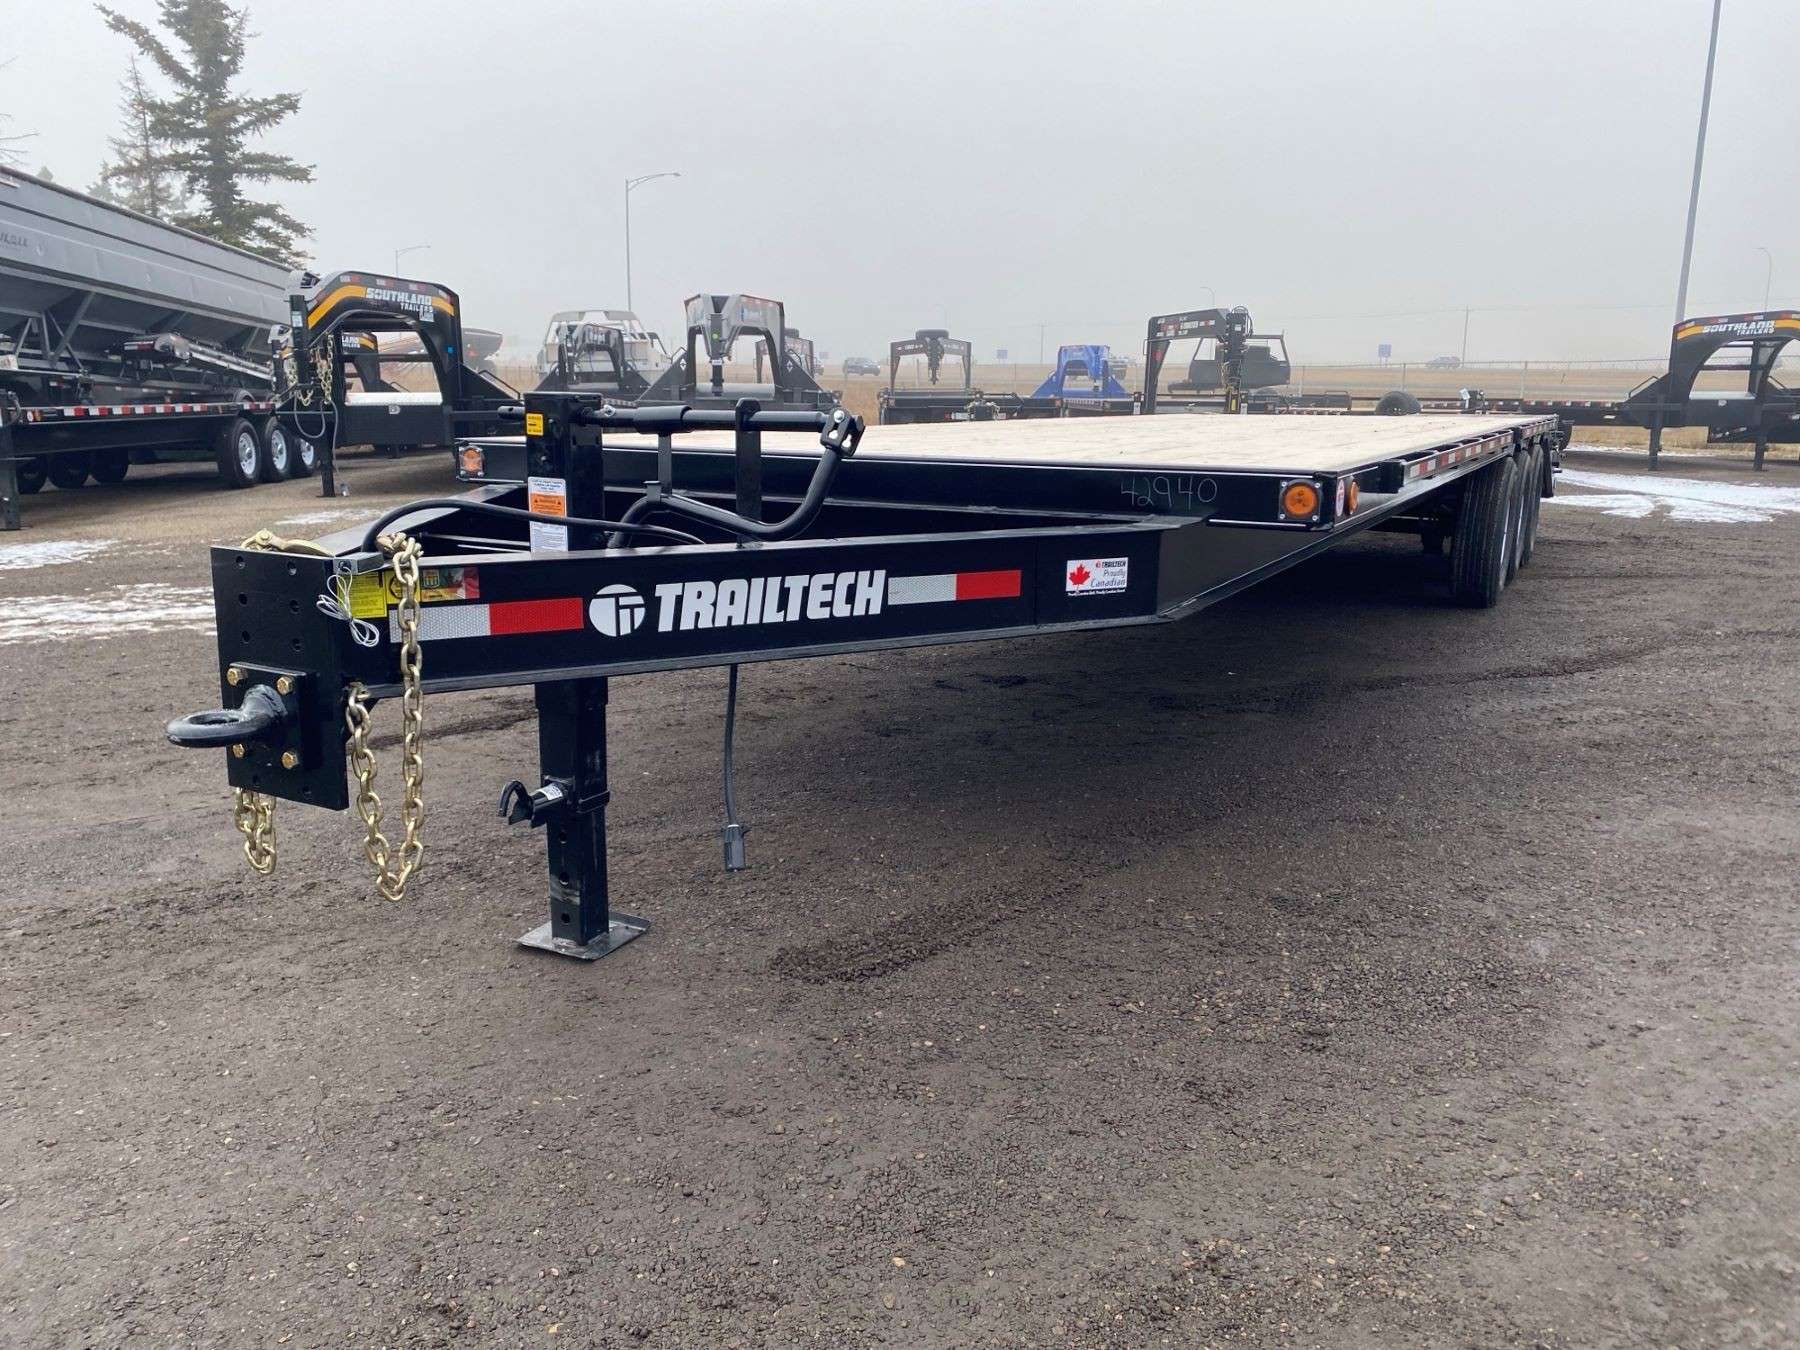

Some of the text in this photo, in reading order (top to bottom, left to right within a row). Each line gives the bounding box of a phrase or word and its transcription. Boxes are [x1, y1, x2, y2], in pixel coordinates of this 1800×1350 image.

[366, 288, 432, 305] SOUTHLAND
[1703, 320, 1776, 333] SOUTHLAND
[1120, 474, 1218, 510] 42940
[1090, 578, 1126, 588] Canadian
[654, 569, 887, 633] TRAILTECH
